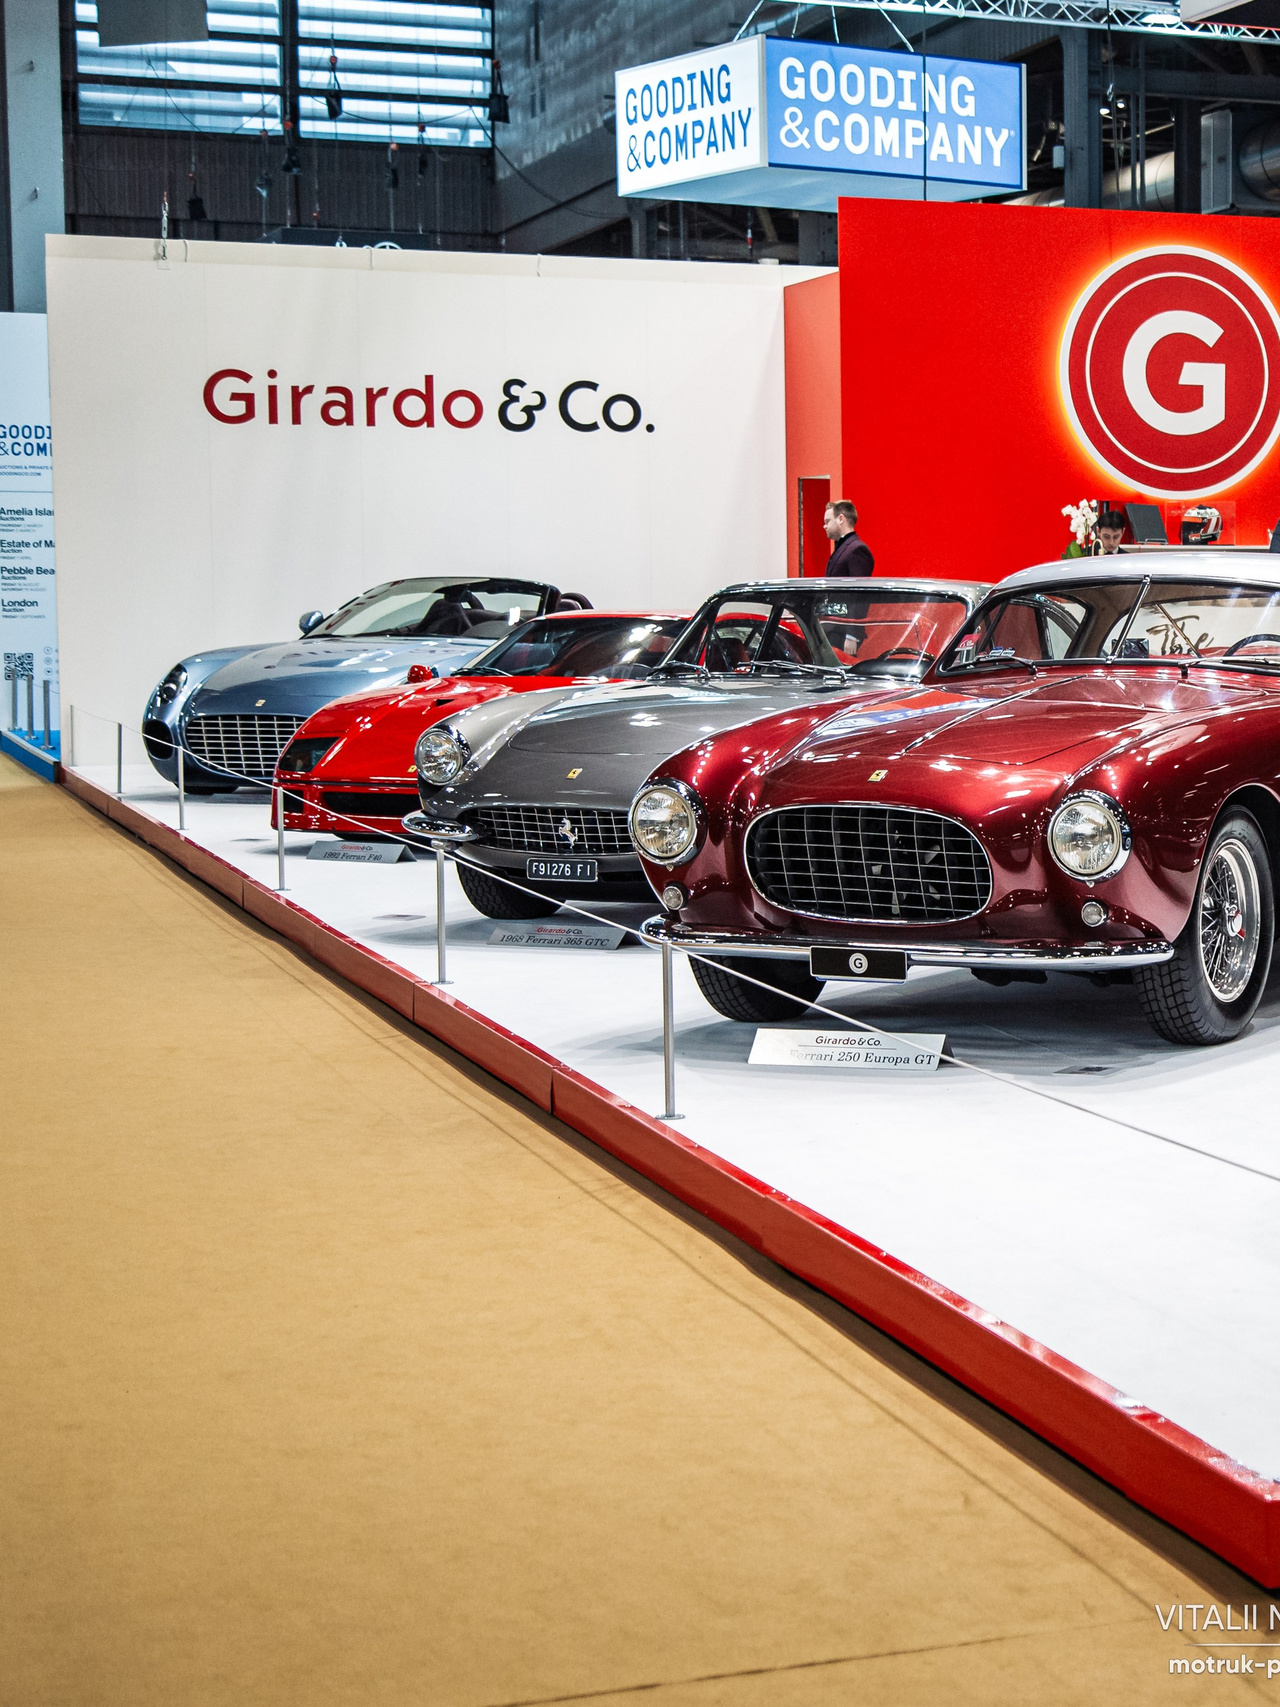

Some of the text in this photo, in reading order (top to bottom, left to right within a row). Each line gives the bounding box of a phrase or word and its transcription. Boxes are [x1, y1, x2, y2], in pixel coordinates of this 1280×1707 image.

[778, 57, 976, 117] GOODING
[625, 63, 732, 125] GOODING
[1122, 310, 1226, 436] G
[202, 368, 656, 433] Girardo & Co.
[0, 441, 53, 457] &COM
[0, 507, 33, 516] Amelia
[1, 540, 31, 548] Estate
[32, 539, 42, 548] of
[1, 566, 34, 575] Pebble
[1, 599, 39, 607] London
[322, 851, 382, 861] 1992 Ferrari F40
[533, 862, 571, 876] F91276
[536, 926, 566, 934] Girardo
[500, 934, 609, 947] 1968 Ferrari 365 GTC
[853, 957, 863, 969] G
[815, 1035, 857, 1046] Girardo
[867, 1038, 882, 1047] Co.
[837, 1051, 860, 1062] 250
[864, 1053, 910, 1066] Europa
[914, 1054, 935, 1065] GT
